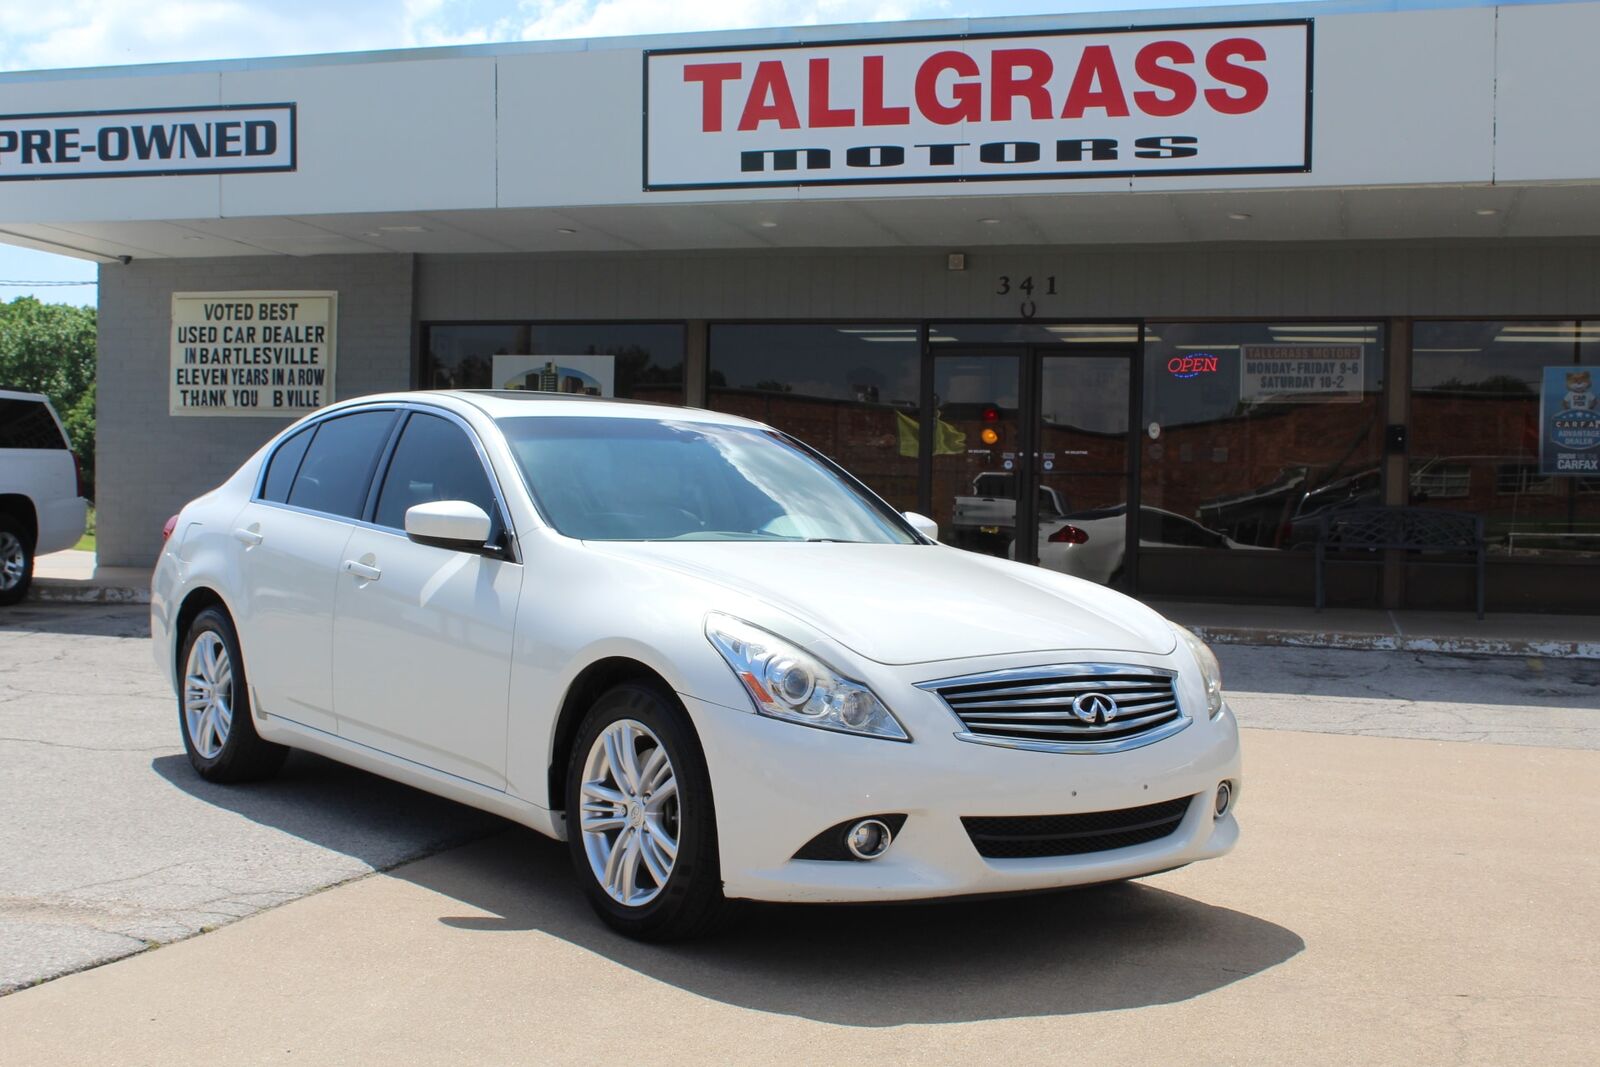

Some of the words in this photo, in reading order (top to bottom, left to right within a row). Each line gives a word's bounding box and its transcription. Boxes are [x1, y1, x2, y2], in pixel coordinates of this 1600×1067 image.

[683, 38, 1269, 132] TALLGRASS
[204, 303, 254, 321] VOTED
[259, 303, 299, 321] BEST
[178, 326, 217, 343] USED
[223, 326, 256, 343] CAR
[262, 326, 325, 343] DEALER
[185, 347, 197, 364] IN
[199, 347, 318, 364] BARTLESVILLE
[1311, 347, 1359, 358] MOTORS
[1167, 357, 1219, 373] OPEN
[1247, 362, 1336, 375] MONDAY-FRIDAY
[176, 368, 228, 385] ELEVEN
[231, 368, 269, 385] YEARS
[272, 368, 284, 385] IN
[287, 368, 295, 385] A
[298, 368, 325, 386] ROW
[1260, 376, 1315, 389] SATURDAY
[180, 389, 226, 407] THANK
[232, 389, 258, 407] YOU
[273, 390, 284, 407] B
[287, 390, 320, 407] VILLE
[1557, 460, 1599, 470] CARFAX
